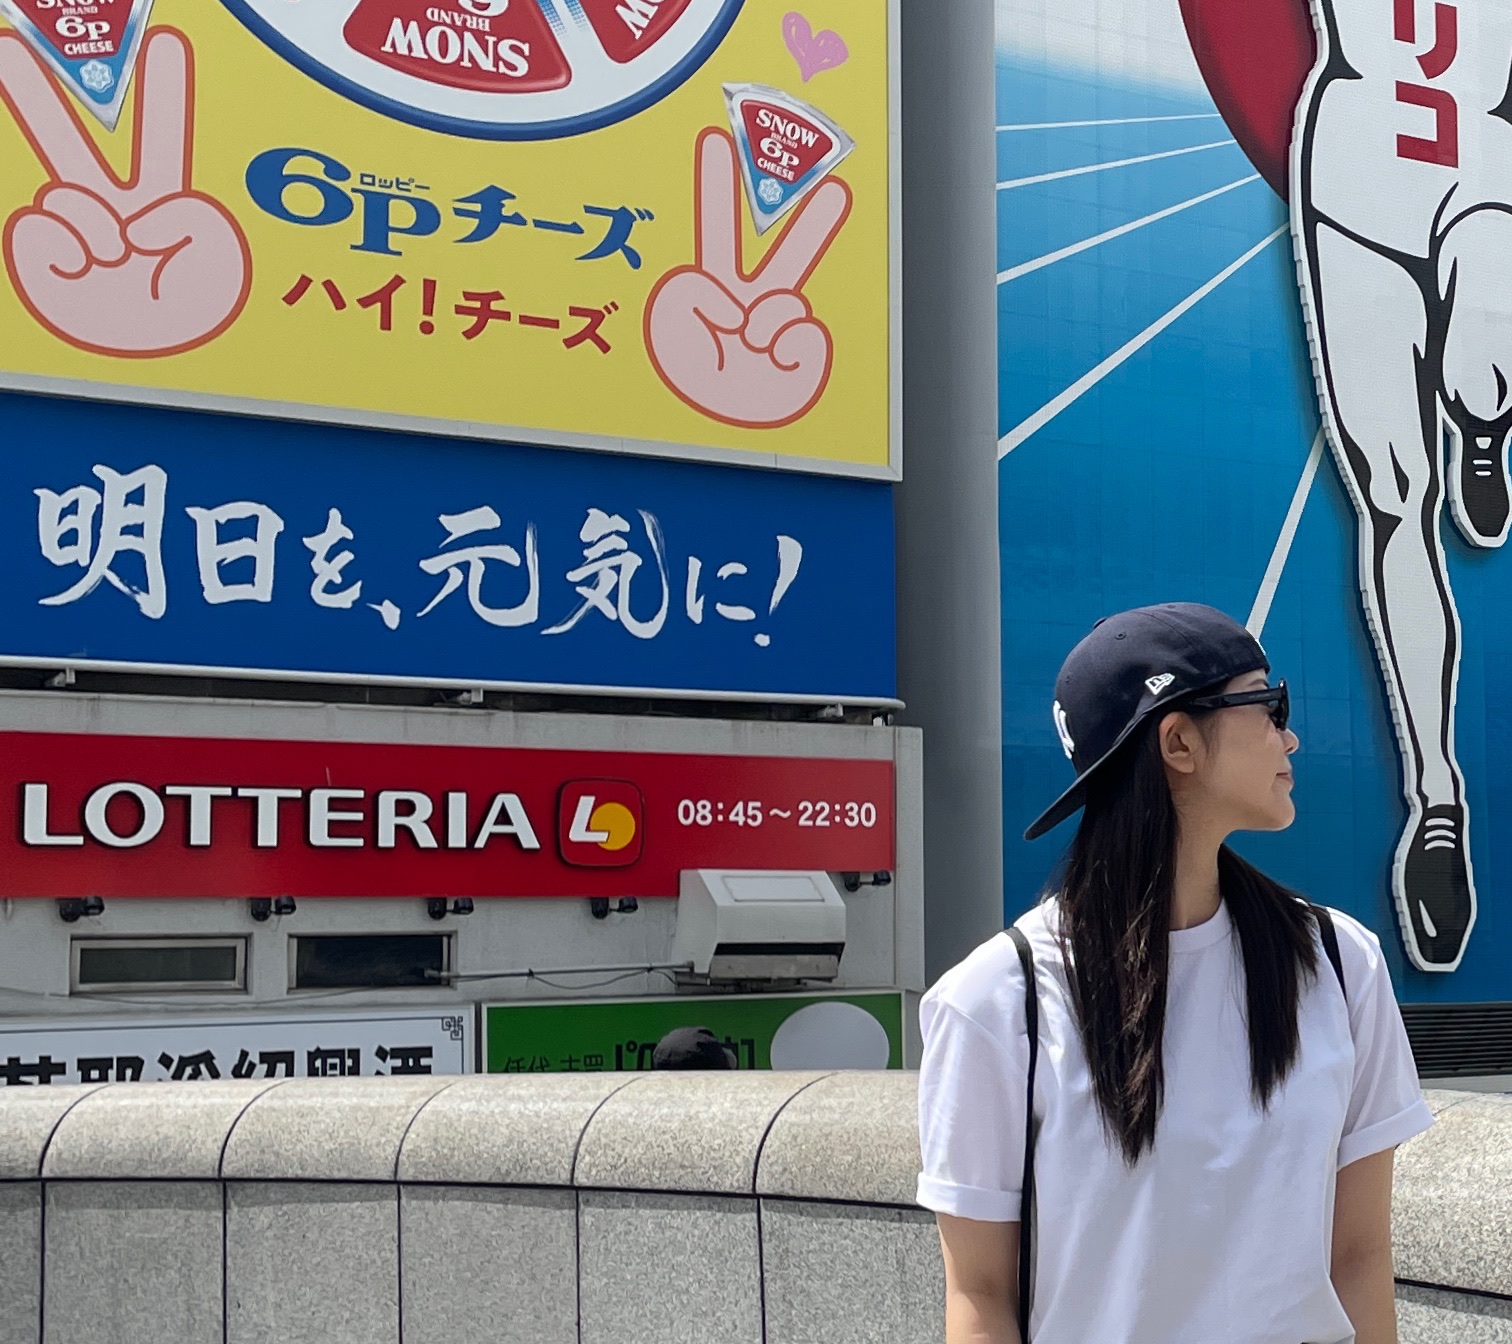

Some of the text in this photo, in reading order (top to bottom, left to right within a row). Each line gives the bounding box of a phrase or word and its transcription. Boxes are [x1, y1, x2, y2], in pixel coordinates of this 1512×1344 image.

[425, 6, 490, 31] BRAND
[64, 40, 114, 55] CHEESE
[380, 17, 530, 78] SNOW
[756, 108, 819, 148] SNOW
[360, 172, 430, 192] ロッピー
[757, 157, 795, 181] CHEESE
[34, 464, 802, 645] 明日を、元気に!
[23, 782, 541, 850] LOTTERIA
